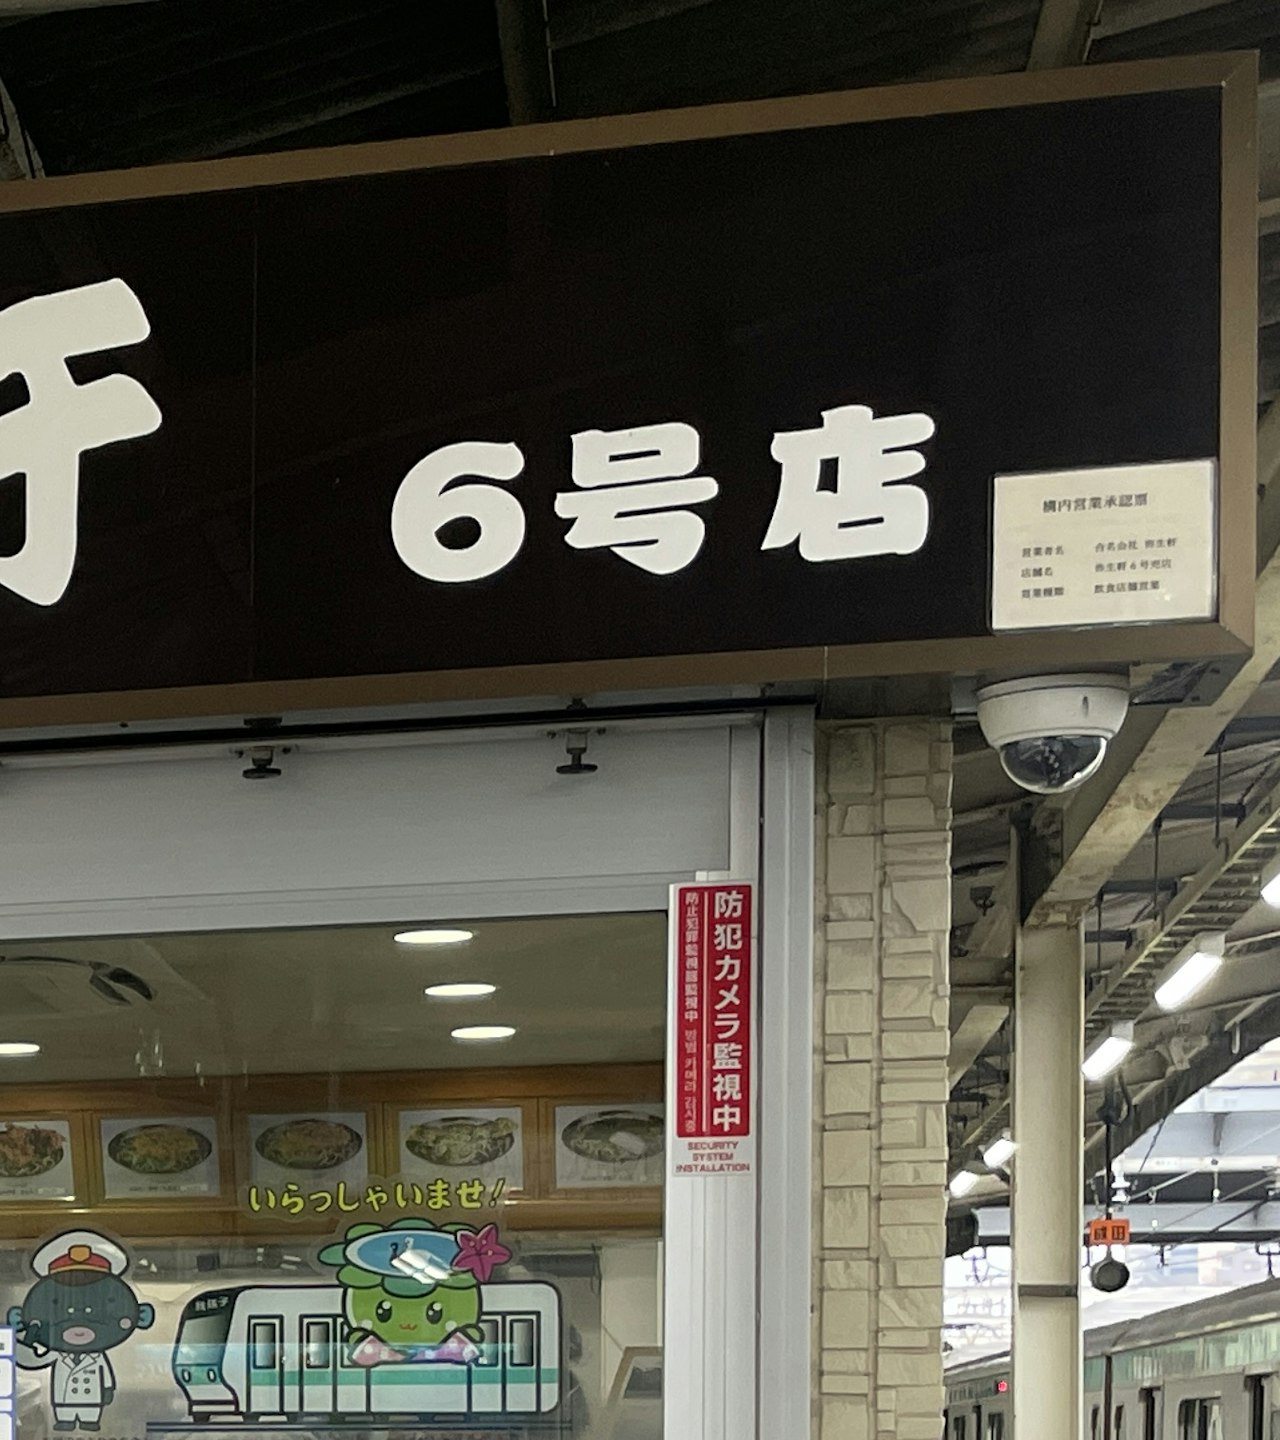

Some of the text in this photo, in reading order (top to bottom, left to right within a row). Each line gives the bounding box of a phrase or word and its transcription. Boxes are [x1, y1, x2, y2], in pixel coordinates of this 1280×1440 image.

[391, 404, 937, 583] 6号店
[712, 889, 744, 1132] 防犯カメラ監視中
[687, 1141, 739, 1151] SECURITY
[692, 1153, 734, 1162] SYSTEM
